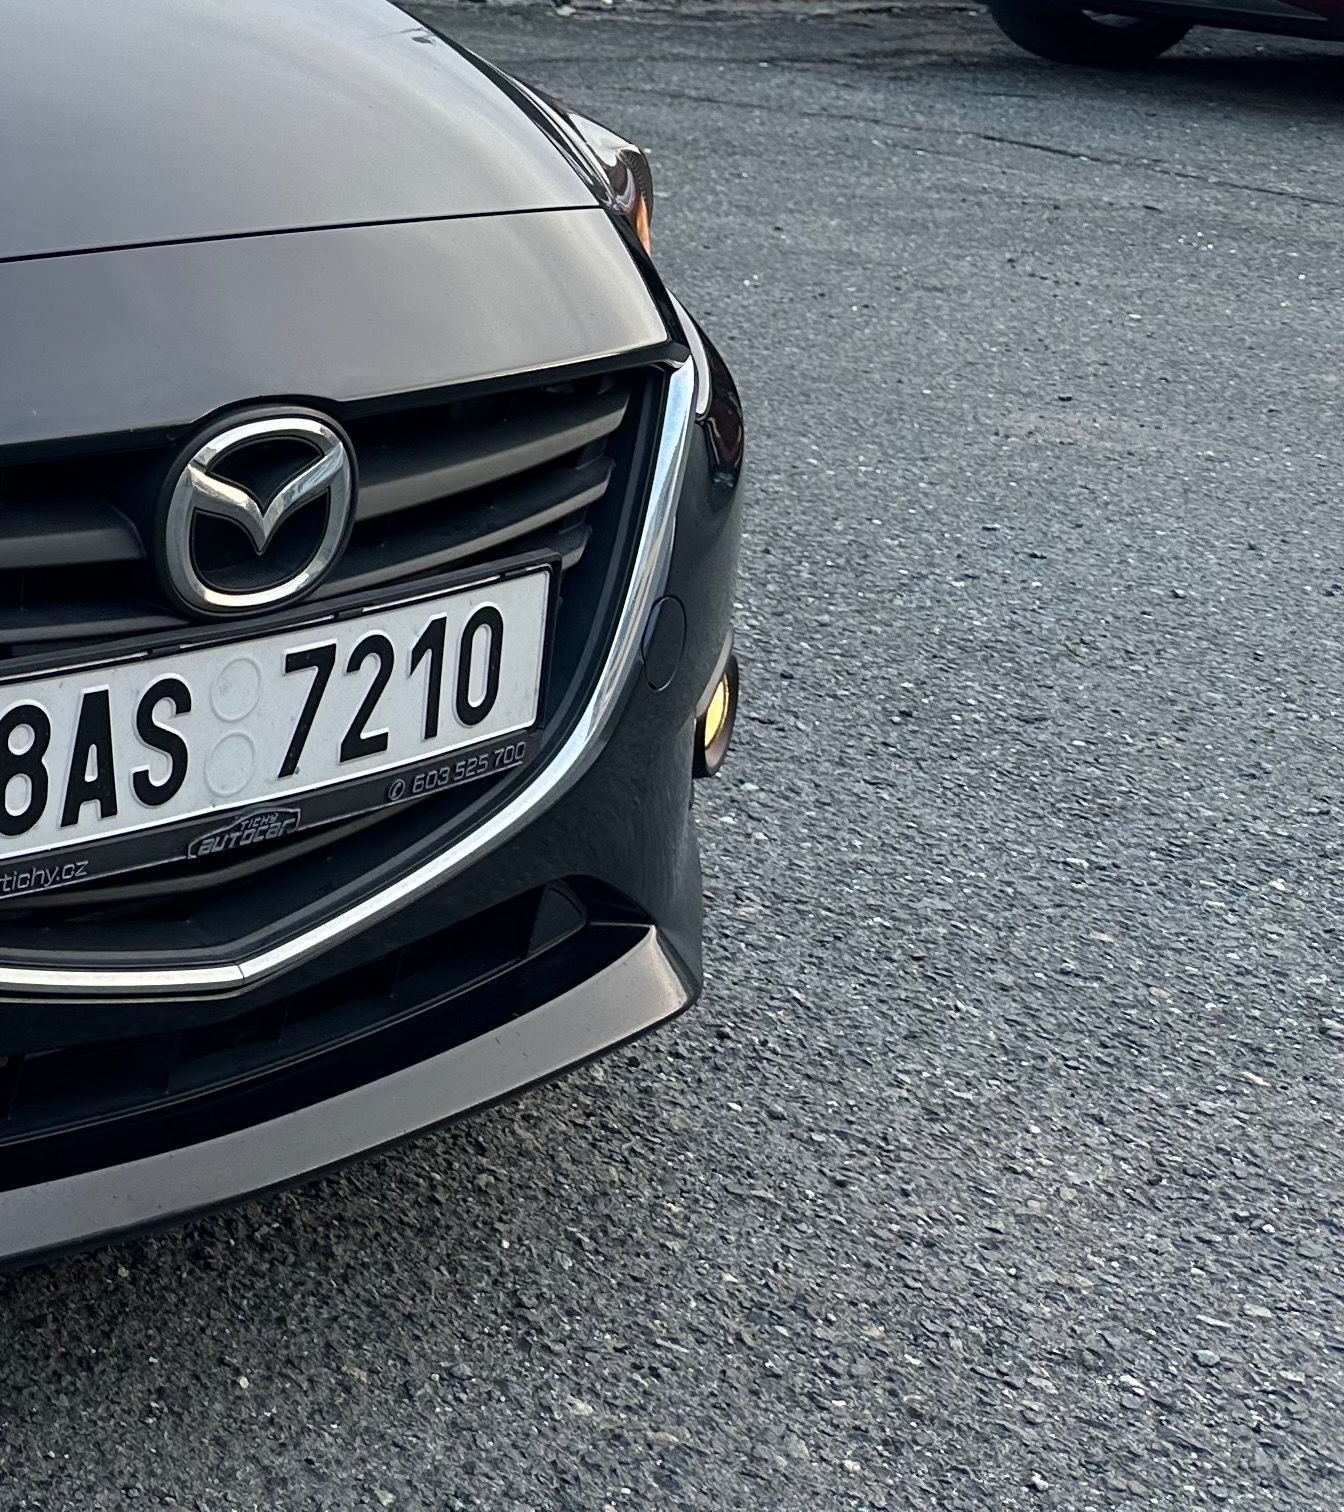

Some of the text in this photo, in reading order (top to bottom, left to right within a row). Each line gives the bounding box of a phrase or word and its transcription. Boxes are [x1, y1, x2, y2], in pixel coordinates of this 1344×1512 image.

[277, 605, 504, 779] 7210
[412, 740, 527, 794] 603 525 700
